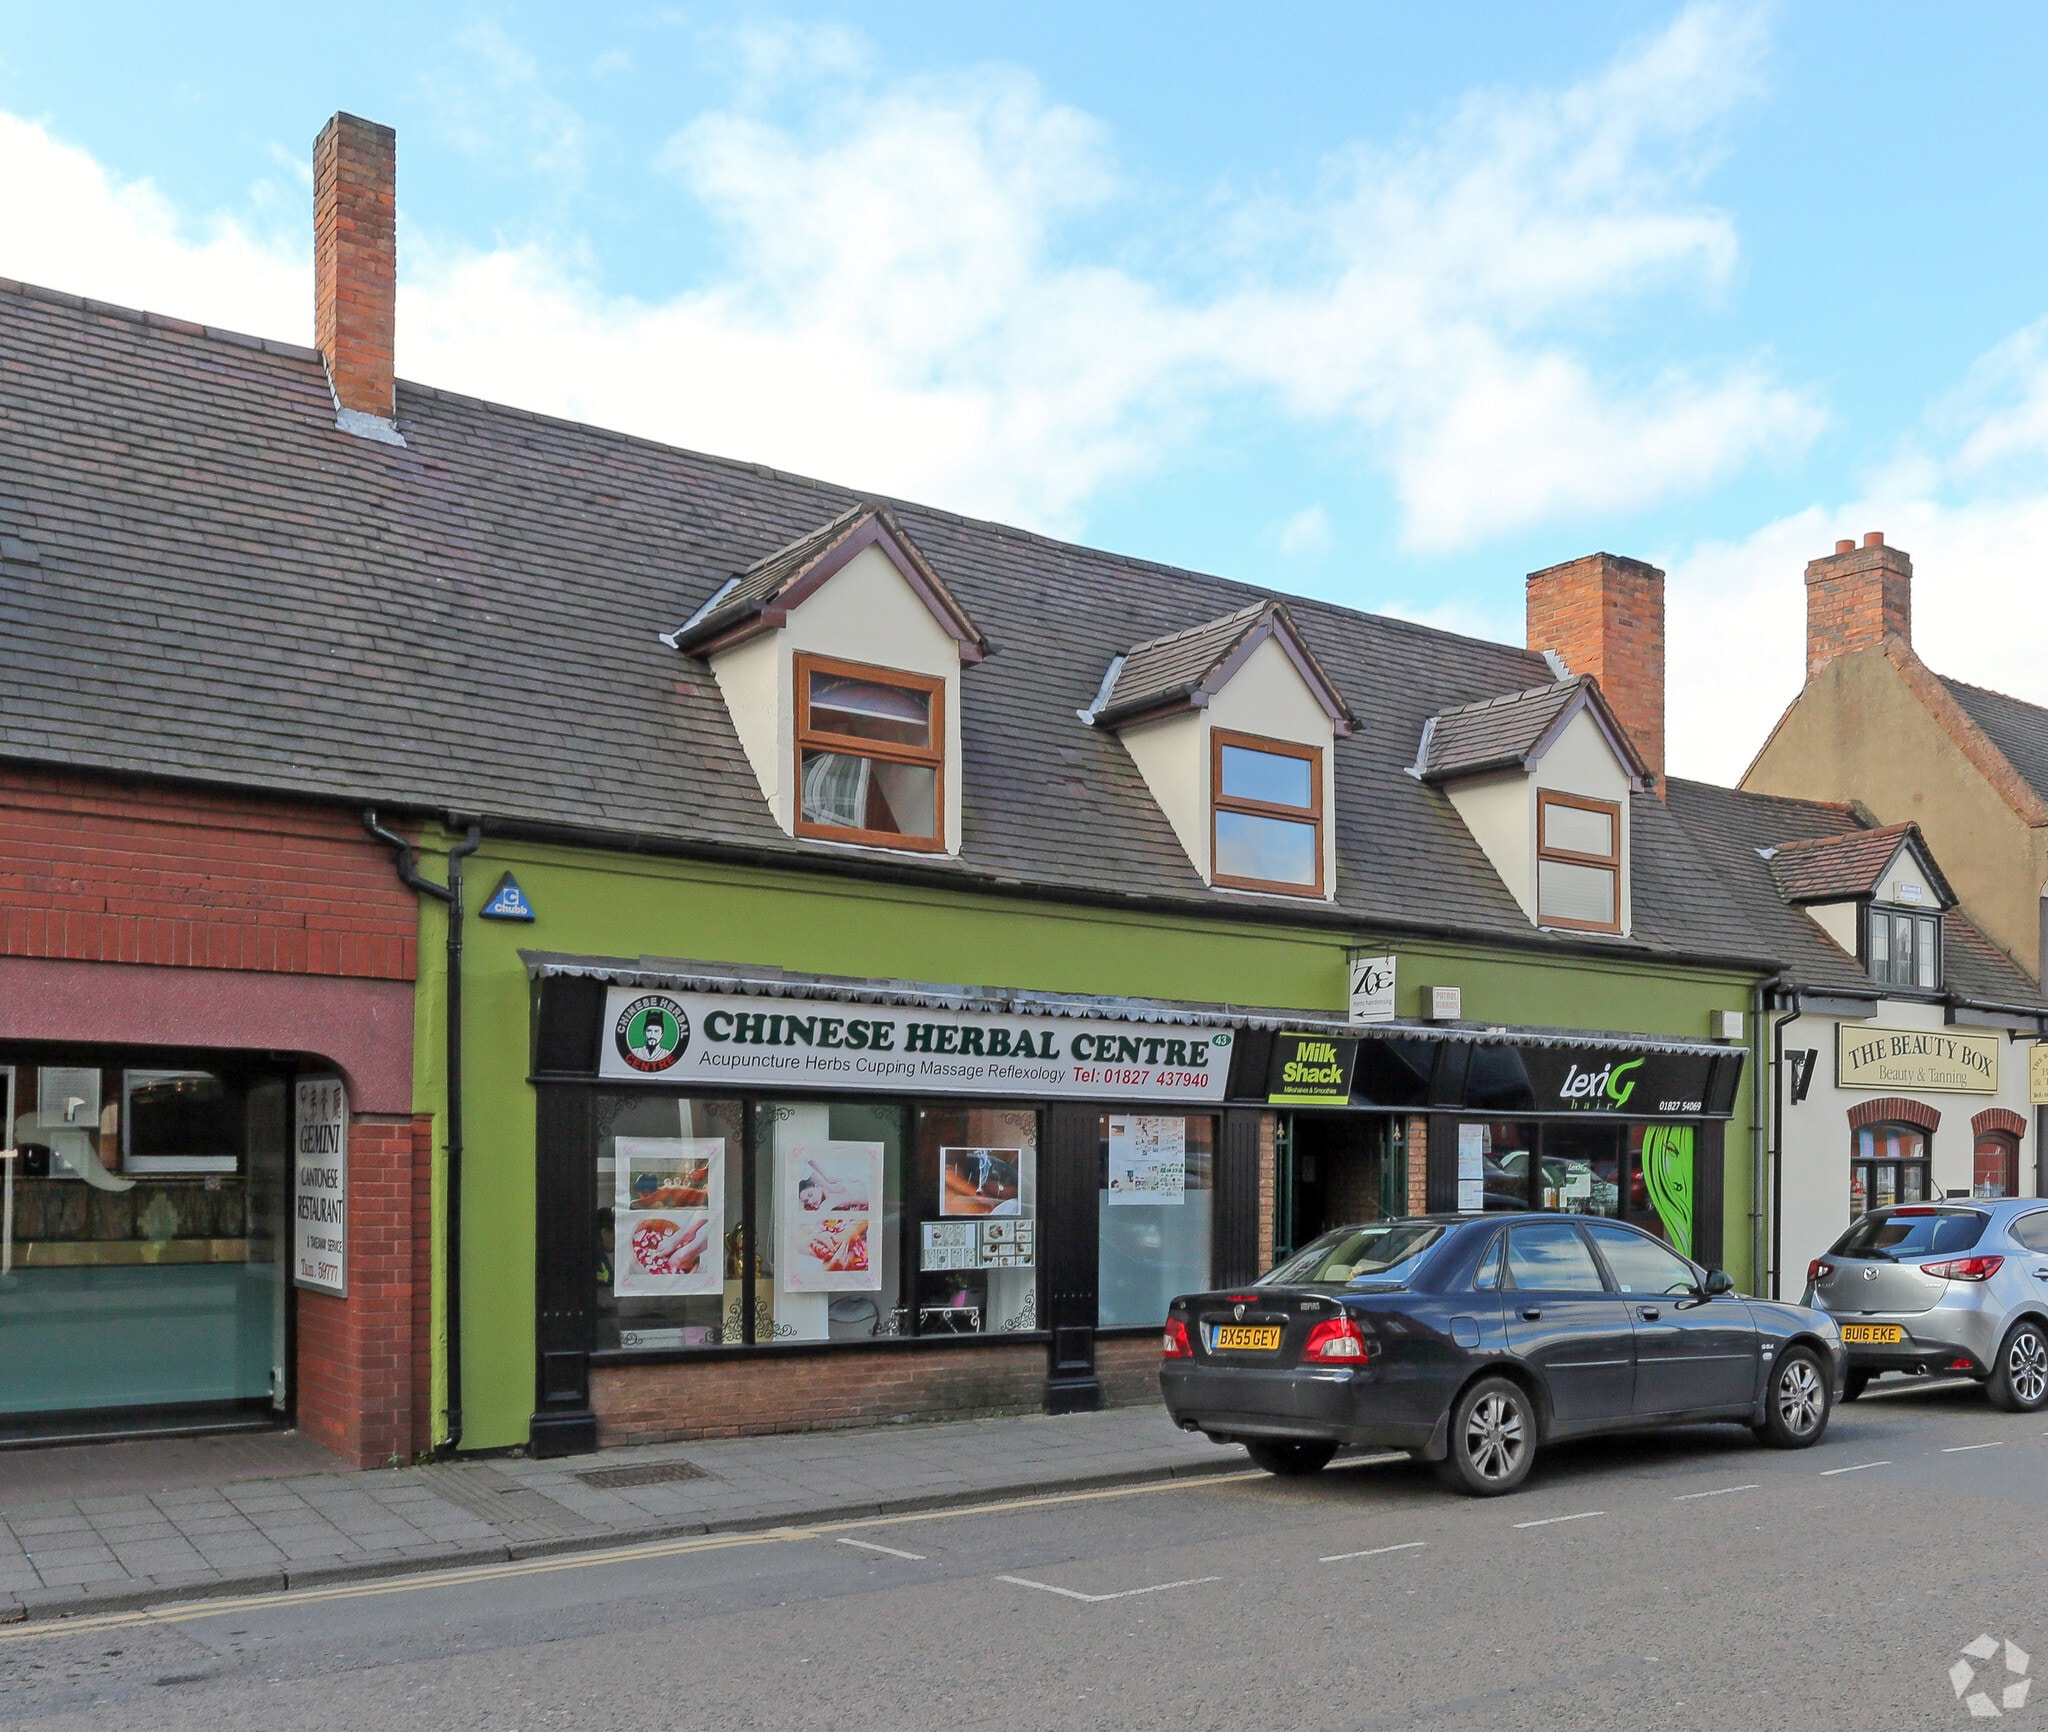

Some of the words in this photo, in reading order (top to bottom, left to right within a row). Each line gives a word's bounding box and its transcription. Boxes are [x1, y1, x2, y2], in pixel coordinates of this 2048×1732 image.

[495, 904, 527, 914] Chubb
[617, 997, 657, 1034] CHINESE
[660, 998, 689, 1039] HERBAL
[703, 1010, 895, 1051] CHINESE
[904, 1023, 1060, 1059] HERBAL
[1070, 1033, 1209, 1067] CENTRE
[1215, 1035, 1227, 1046] 43
[625, 1053, 676, 1071] CENTRE
[1296, 1042, 1337, 1063] Milk
[1848, 1039, 1887, 1070] THE
[1890, 1035, 1958, 1059] BEAUTY
[1961, 1045, 1993, 1078] BOX
[699, 1051, 800, 1069] Acupuncture
[805, 1055, 851, 1072] Herbs
[855, 1057, 916, 1077] Cupping
[920, 1060, 984, 1079] Massage
[988, 1064, 1065, 1083] Reflexology
[1073, 1067, 1100, 1083] Tel:
[1104, 1068, 1149, 1085] 01827
[1156, 1072, 1208, 1087] 437940
[1283, 1062, 1343, 1084] Shack
[1878, 1065, 1914, 1085] Beauty
[1917, 1068, 1926, 1082] &
[1928, 1067, 1967, 1087] Tanning
[1571, 1099, 1613, 1111] hair
[1659, 1101, 1680, 1111] 01827
[301, 1124, 340, 1154] GEMINI
[302, 1167, 338, 1188] CANTONESE
[298, 1195, 342, 1224] RESTAURANT
[1221, 1329, 1251, 1345] BX55
[1253, 1330, 1277, 1346] GEY
[1845, 1328, 1870, 1340] BU16
[1873, 1328, 1896, 1341] EKE
